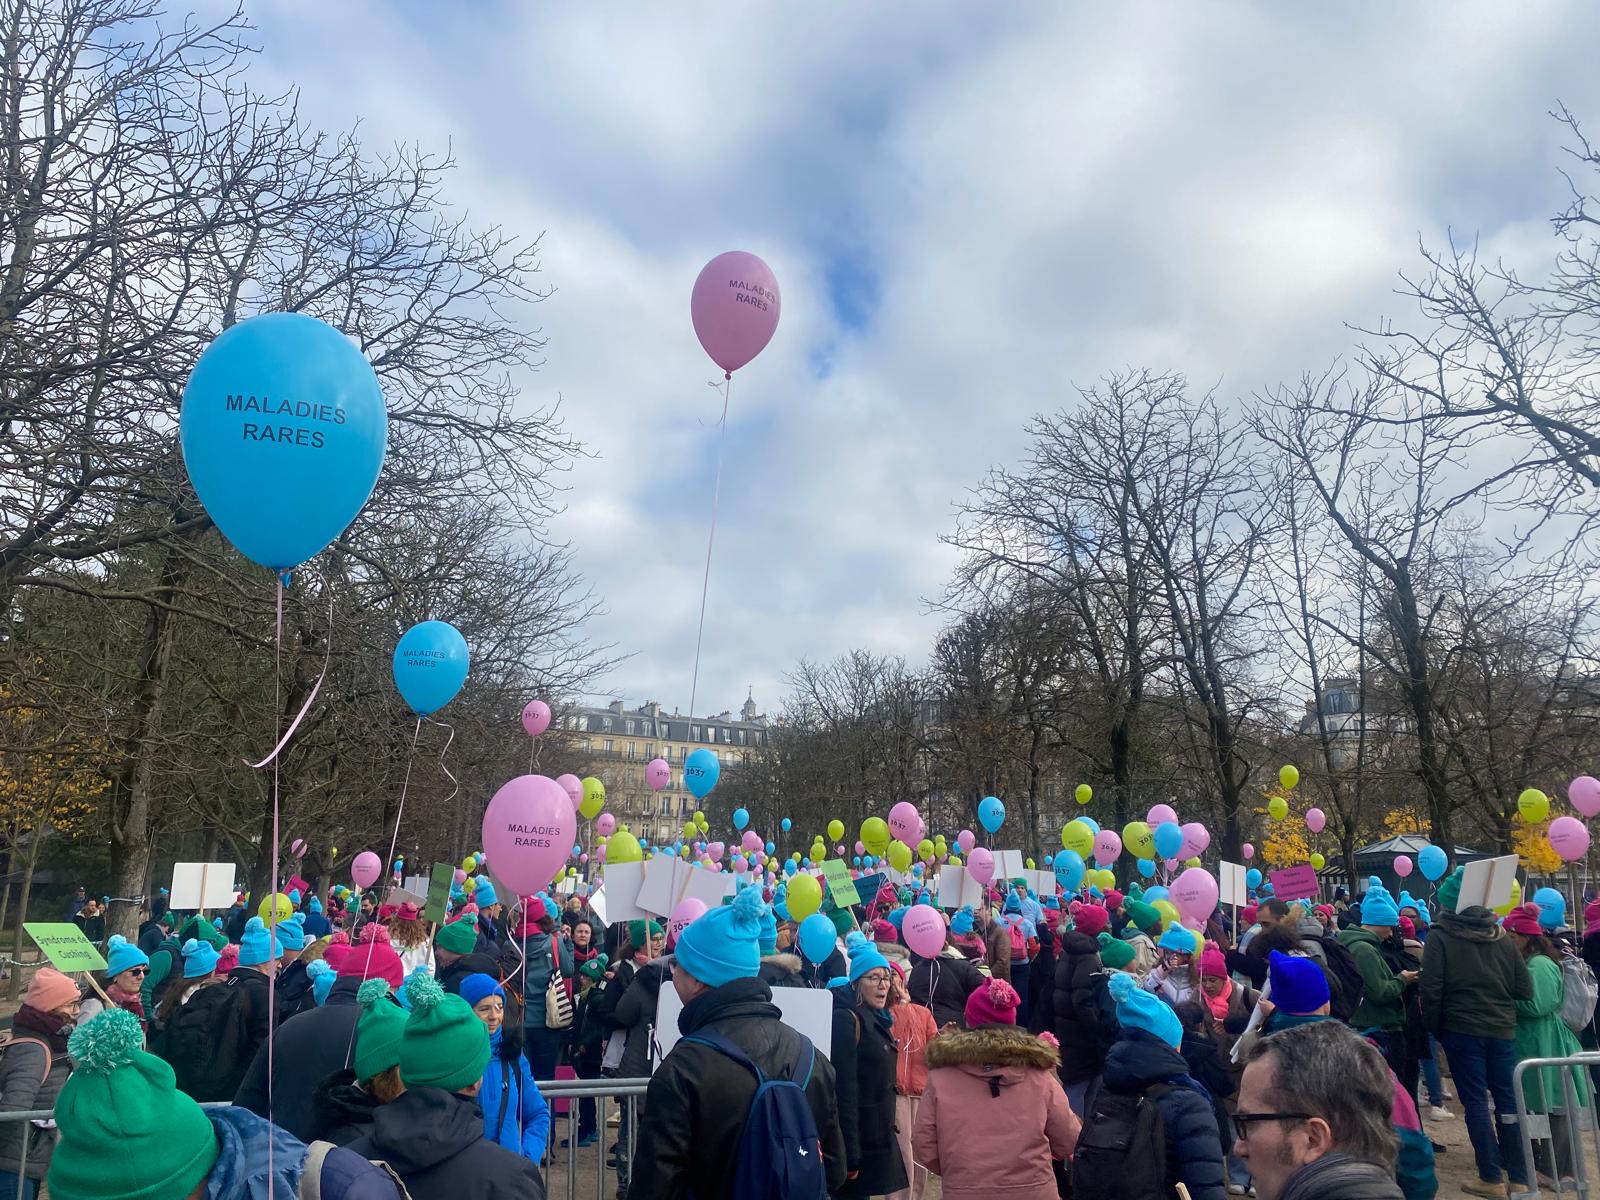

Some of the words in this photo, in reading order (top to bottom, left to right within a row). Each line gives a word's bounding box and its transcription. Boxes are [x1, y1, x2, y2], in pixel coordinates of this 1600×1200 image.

[729, 280, 775, 304] MALADIES
[736, 292, 768, 312] RARES
[226, 394, 346, 425] MALADIES
[243, 423, 325, 449] RARES
[403, 650, 446, 659] MALADIES
[407, 659, 437, 668] RARES
[686, 767, 705, 777] 3637
[508, 823, 561, 836] MALADIES
[514, 837, 551, 848] RARES
[36, 936, 77, 946] Syndrome
[58, 949, 92, 960] Cushing
